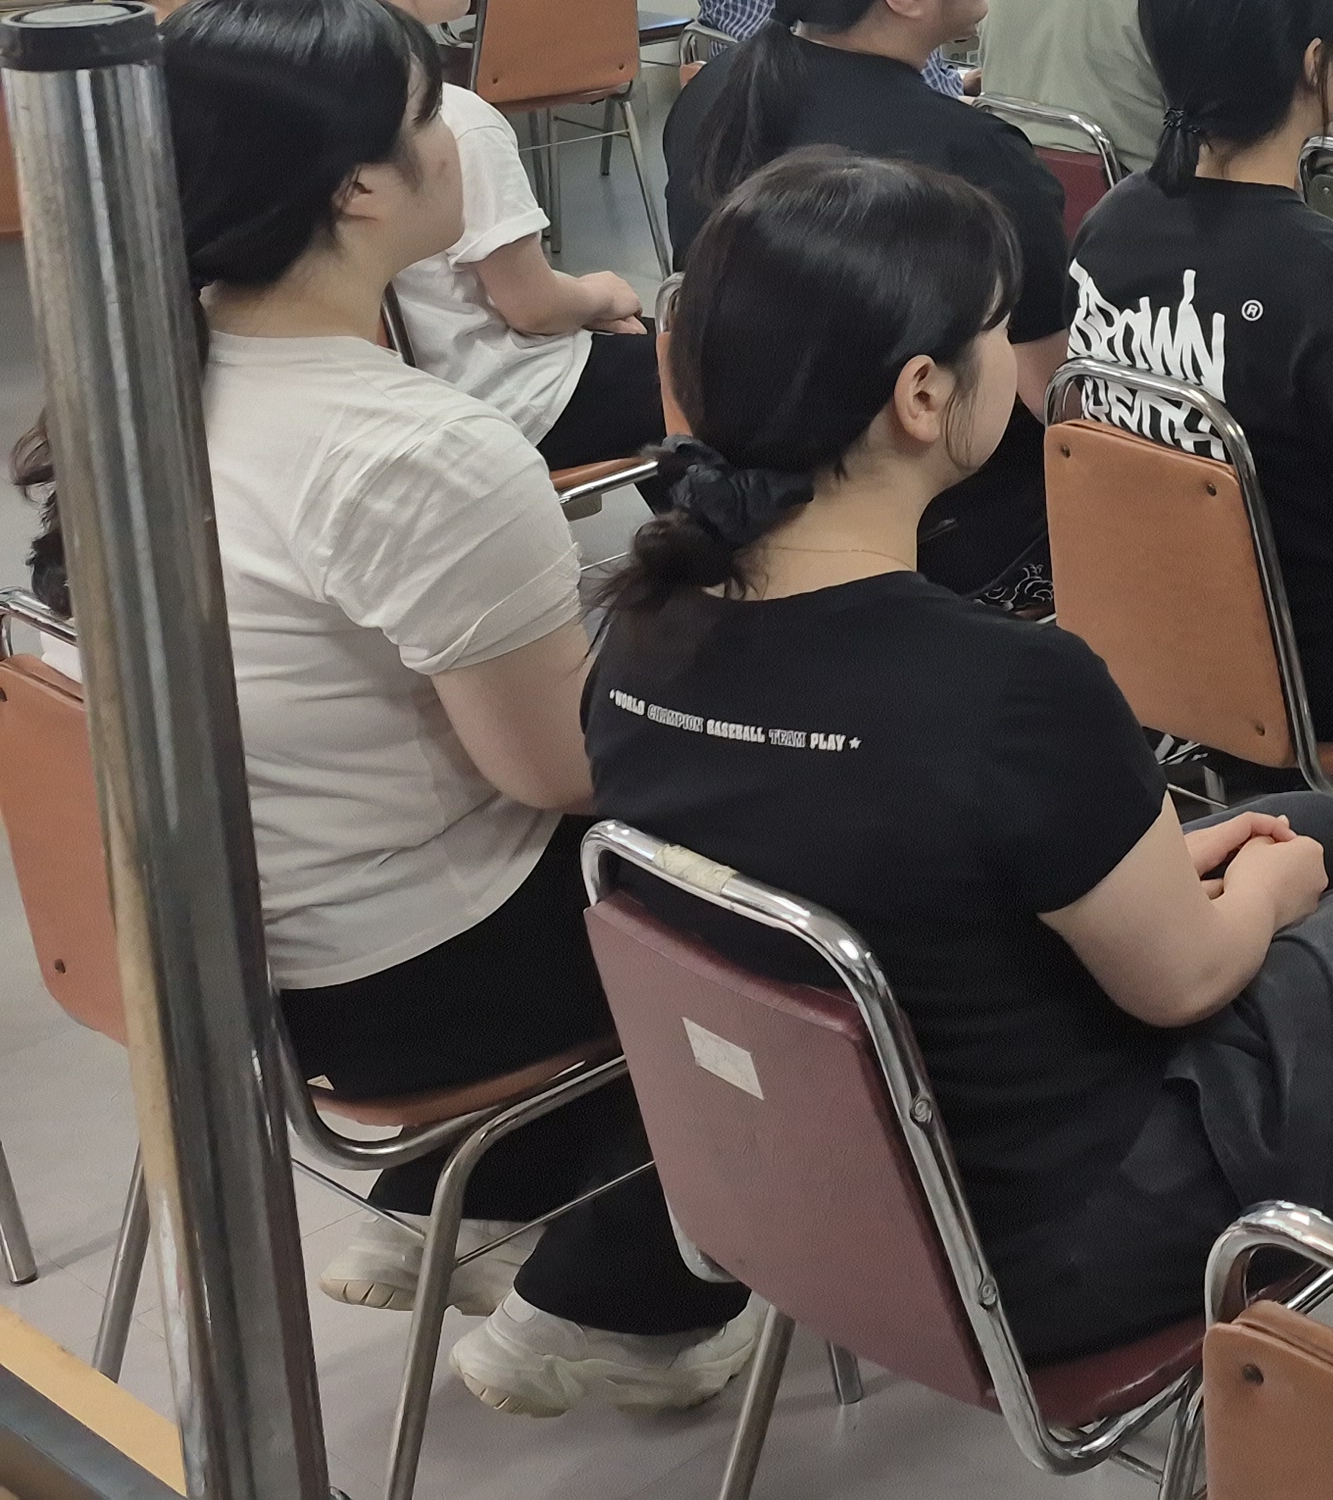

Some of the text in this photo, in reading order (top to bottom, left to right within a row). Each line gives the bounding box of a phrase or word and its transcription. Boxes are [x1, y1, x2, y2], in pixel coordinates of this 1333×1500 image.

[647, 703, 704, 733] CHAMPION
[706, 719, 766, 743] BASEBALL
[768, 728, 807, 748] TEAM
[810, 732, 846, 752] PLAY
